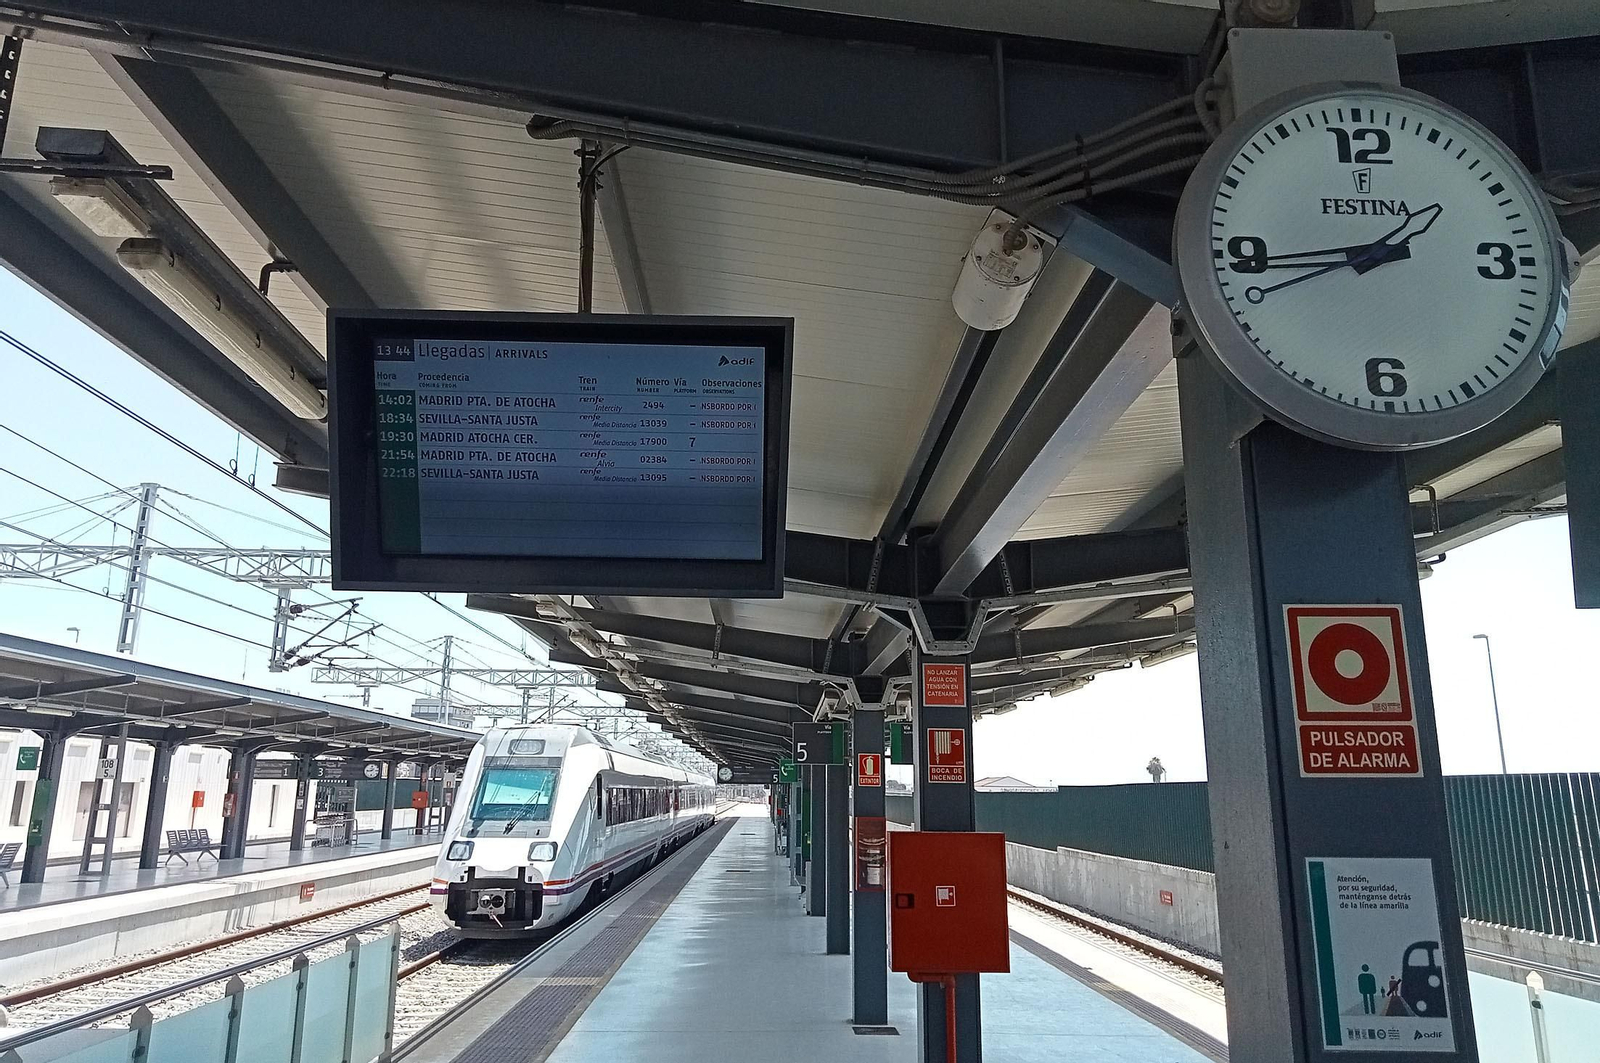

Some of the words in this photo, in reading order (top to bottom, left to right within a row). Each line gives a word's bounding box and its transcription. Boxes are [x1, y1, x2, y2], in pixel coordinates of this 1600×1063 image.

[1326, 128, 1393, 164] 12
[1320, 198, 1411, 217] FESTINA
[1228, 236, 1268, 274] 9
[1477, 242, 1516, 280] 3
[377, 345, 391, 356] 13
[395, 346, 411, 356] 44
[418, 344, 485, 360] Llegadas
[495, 350, 548, 359] ARRIVALS
[730, 358, 755, 366] adif
[377, 372, 397, 380] Hora
[418, 372, 470, 382] Procedencia
[578, 376, 597, 384] Tren
[1365, 357, 1407, 397] 6
[636, 377, 670, 386] Número
[674, 378, 687, 386] Vía
[702, 379, 762, 388] Observaciones
[378, 394, 412, 405] 14:02
[419, 395, 463, 406] MADRID
[467, 396, 491, 406] PTA.
[496, 397, 510, 407] DE
[514, 397, 556, 408] ATOCHA
[579, 395, 604, 404] renfe
[738, 403, 751, 411] POR
[379, 413, 413, 423] 18:34
[419, 414, 502, 425] SEVILLA-SANTA
[506, 415, 538, 426] JUSTA
[380, 432, 414, 442] 19:30
[420, 432, 464, 443] MADRID
[468, 433, 510, 443] ATOCHA
[514, 434, 538, 444] CER.
[689, 437, 696, 447] 7
[381, 450, 415, 460] 21:54
[421, 450, 464, 461] MADRID
[469, 451, 492, 461] PTA.
[498, 452, 511, 462] DE
[515, 452, 557, 462] ATOCHA
[580, 450, 607, 459] renfe
[382, 468, 416, 478] 22:18
[421, 468, 503, 479] SEVILLA-SANTA
[507, 470, 539, 480] JUSTA
[580, 468, 601, 476] renfe
[1310, 731, 1404, 747] PULSADOR
[797, 743, 808, 761] 5
[101, 760, 114, 768] 108
[1310, 753, 1333, 767] DE
[1338, 753, 1410, 768] ALARMA
[283, 768, 288, 776] 1
[318, 768, 323, 776] 3
[1337, 875, 1369, 883] Atención,
[1361, 884, 1397, 893] seguridad,
[1339, 893, 1387, 901] manténganse
